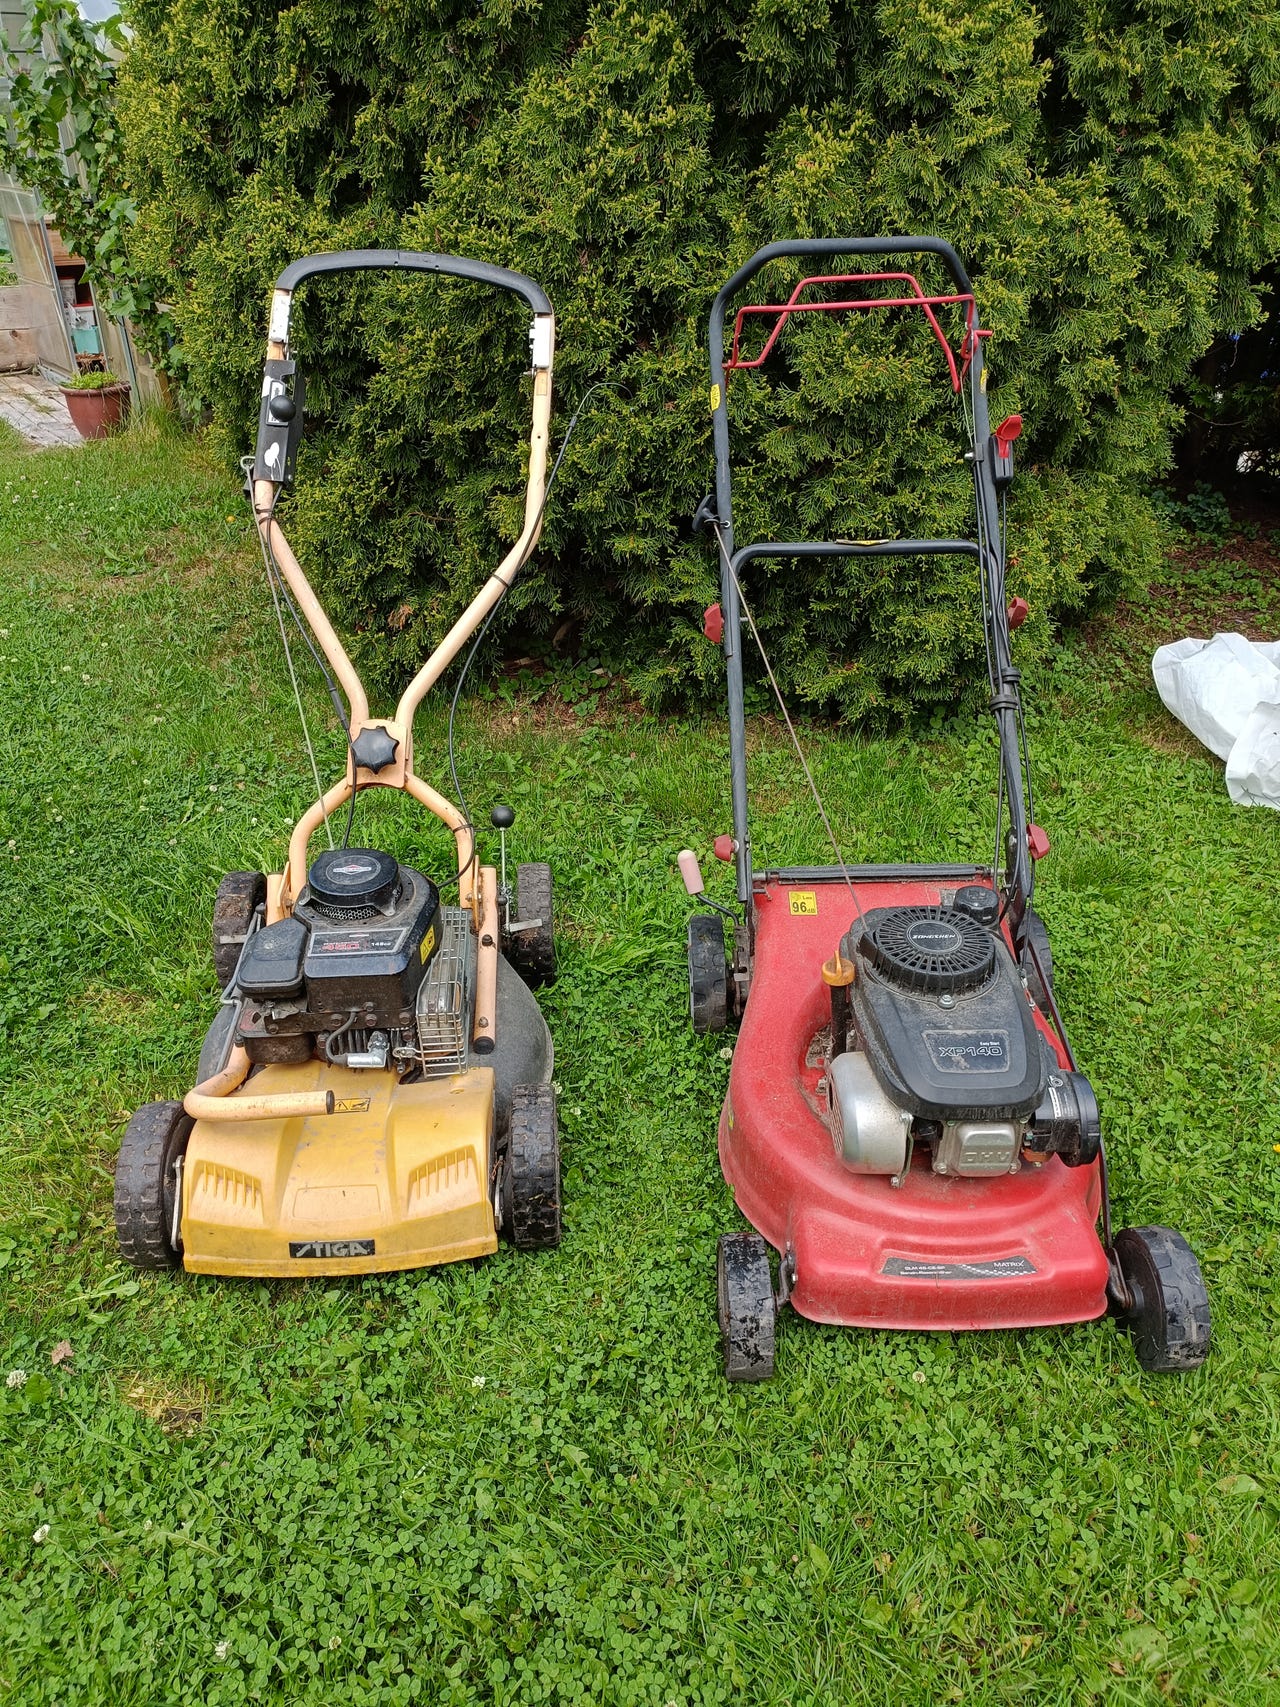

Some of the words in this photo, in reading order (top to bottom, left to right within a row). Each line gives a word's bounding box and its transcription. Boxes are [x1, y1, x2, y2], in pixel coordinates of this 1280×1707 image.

[792, 901, 807, 913] 96
[939, 1046, 1002, 1056] XP140
[296, 1243, 368, 1257] STIGA
